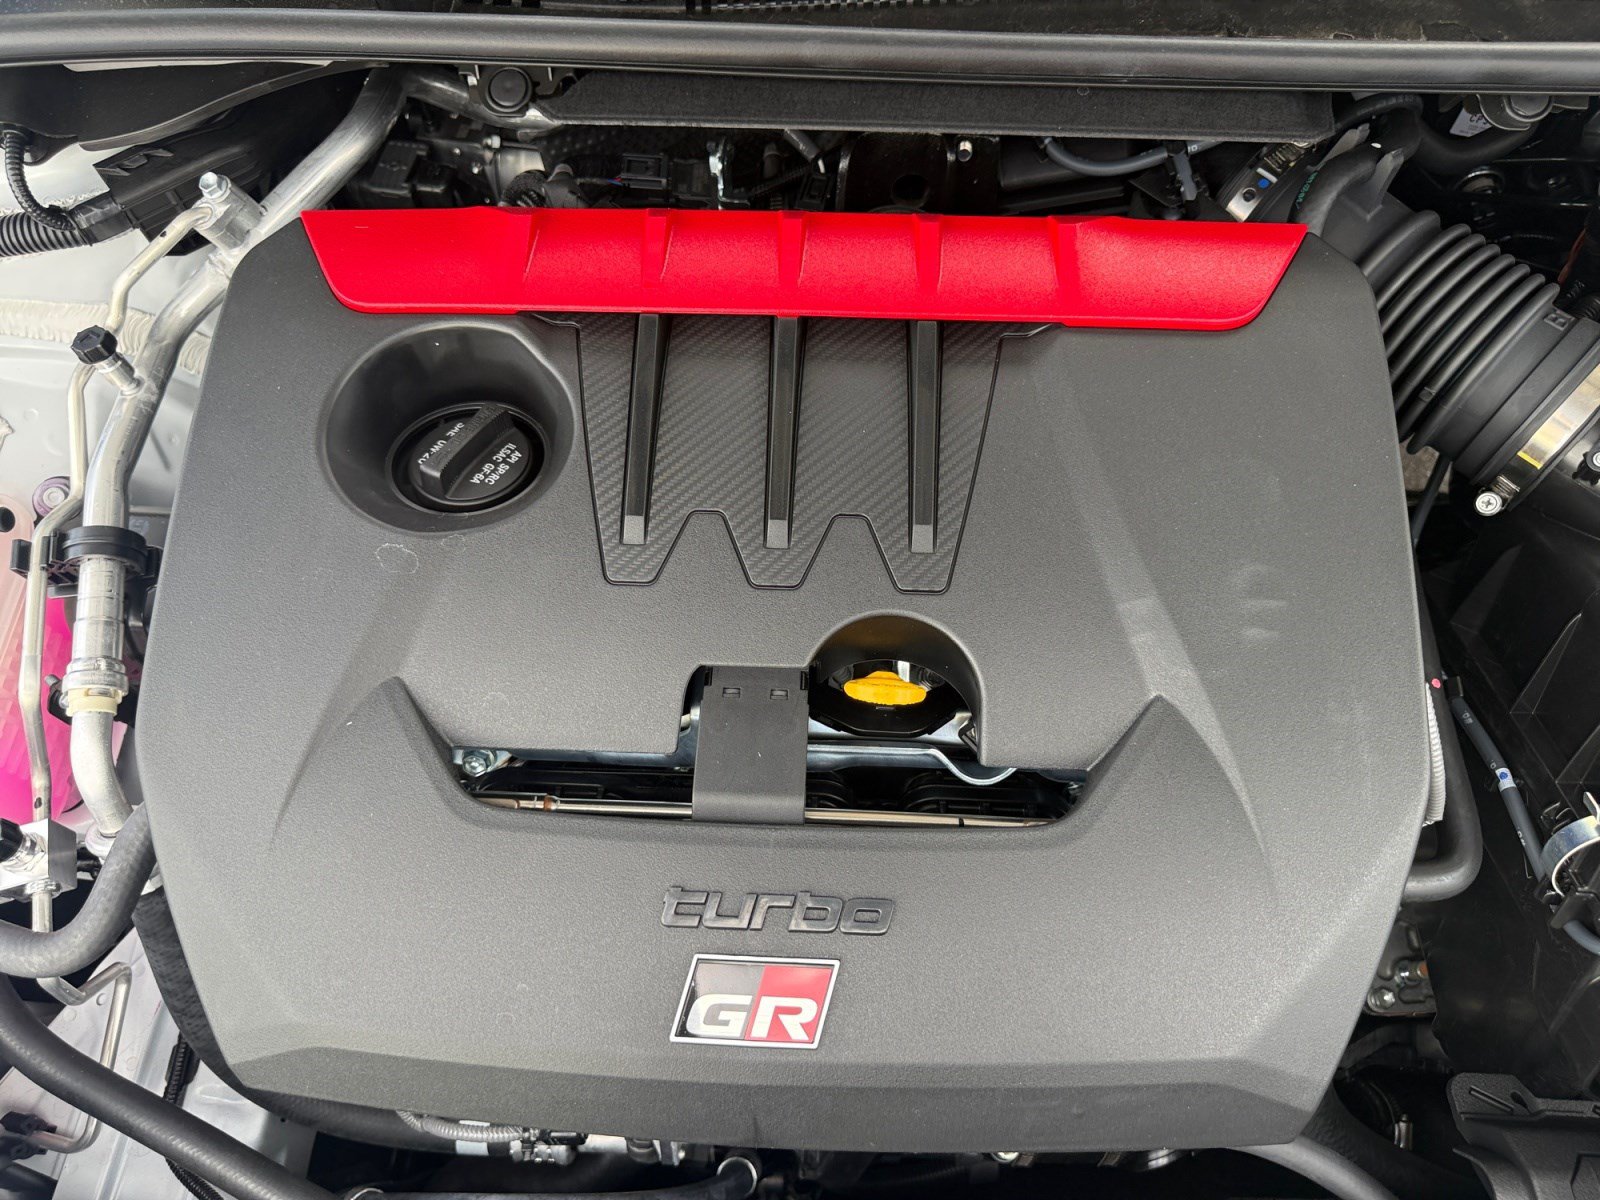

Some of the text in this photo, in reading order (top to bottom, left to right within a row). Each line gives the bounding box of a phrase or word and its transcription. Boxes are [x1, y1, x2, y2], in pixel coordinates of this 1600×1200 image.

[469, 443, 517, 484] ILSAC GF-6A
[484, 451, 523, 485] API SP/RC
[660, 886, 896, 936] turbo
[686, 994, 819, 1041] GR
